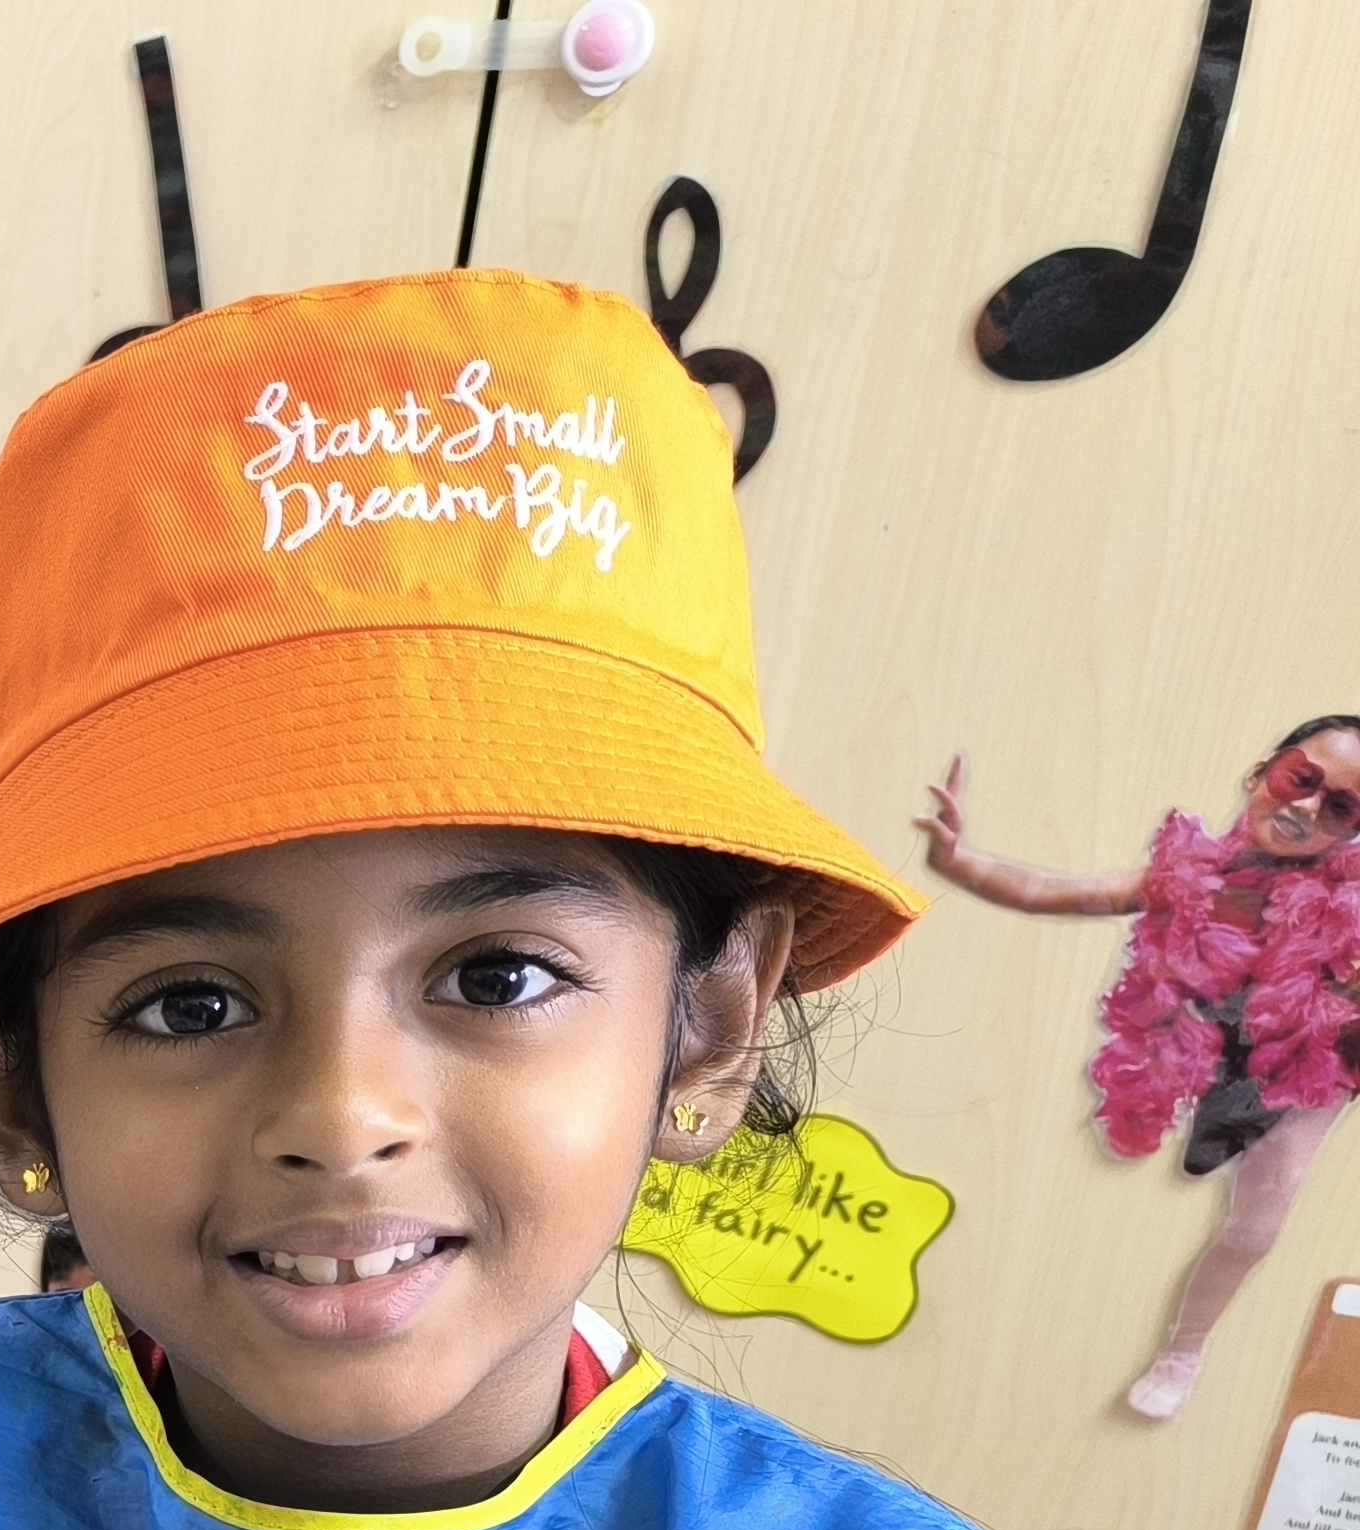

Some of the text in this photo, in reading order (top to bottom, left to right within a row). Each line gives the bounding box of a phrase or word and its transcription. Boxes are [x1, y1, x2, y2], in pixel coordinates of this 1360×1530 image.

[244, 359, 625, 480] Start Small
[260, 463, 631, 573] Dream Big
[793, 1161, 889, 1233] like
